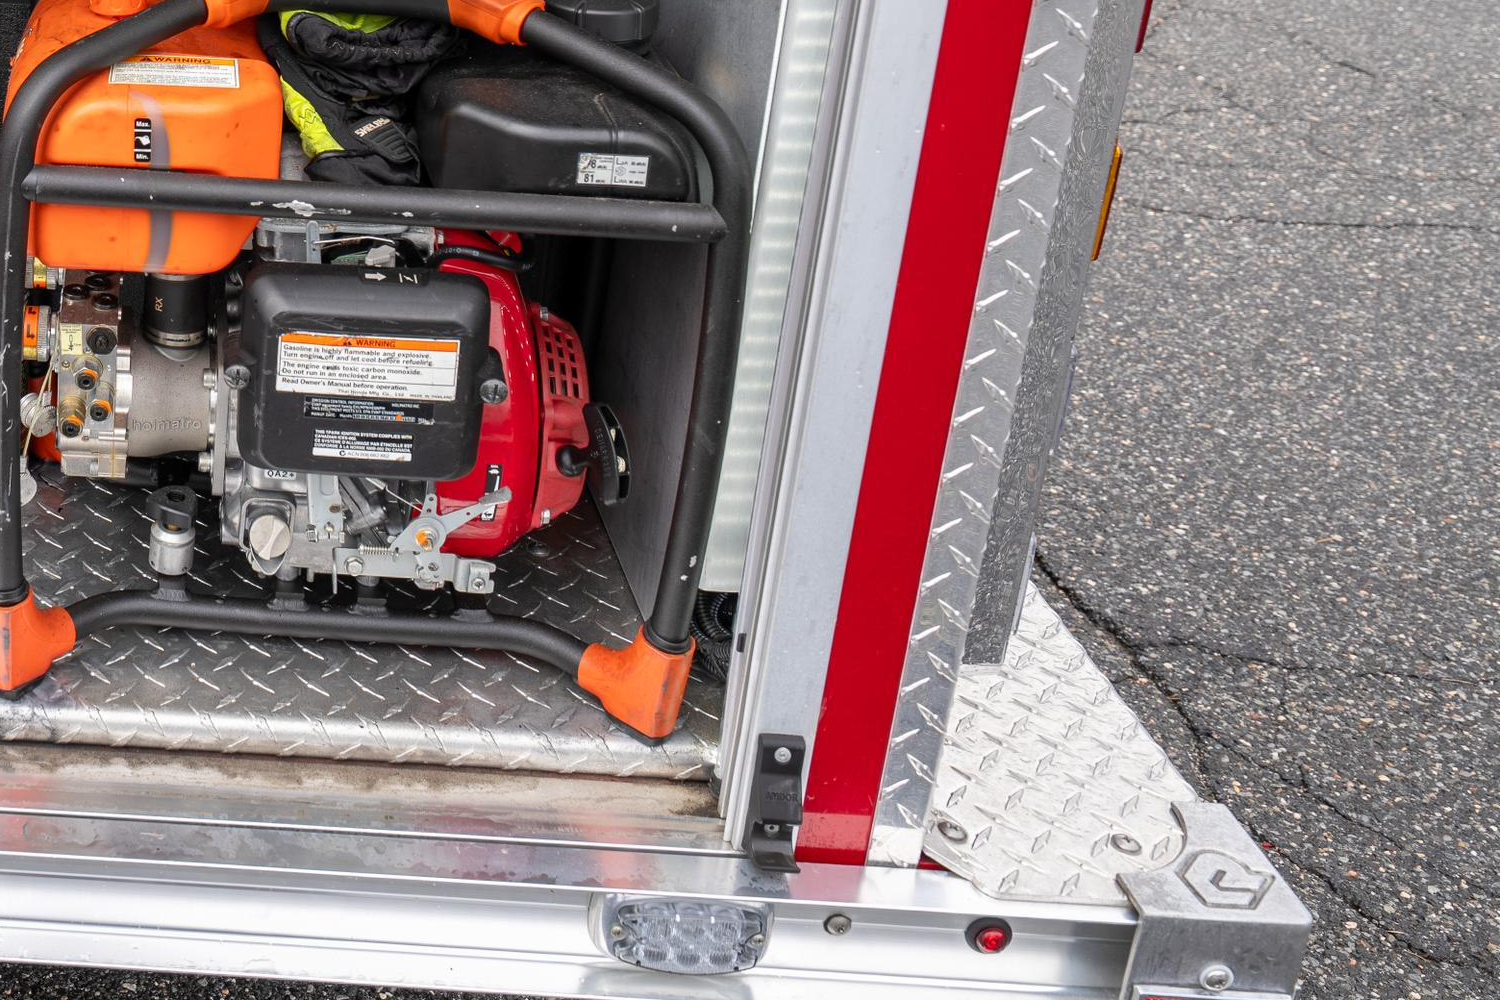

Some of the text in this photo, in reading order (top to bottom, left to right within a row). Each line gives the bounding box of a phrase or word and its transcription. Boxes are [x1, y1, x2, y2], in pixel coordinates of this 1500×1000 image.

[154, 56, 211, 64] WARNING
[584, 173, 594, 183] 81
[155, 297, 164, 312] RX
[356, 340, 396, 348] WARNING
[283, 344, 312, 352] Gasoline
[322, 347, 342, 355] highly
[344, 348, 380, 356] flammable
[378, 356, 400, 364] before
[338, 371, 369, 380] enclosed
[327, 380, 351, 388] Manual
[131, 418, 202, 432] holmatro
